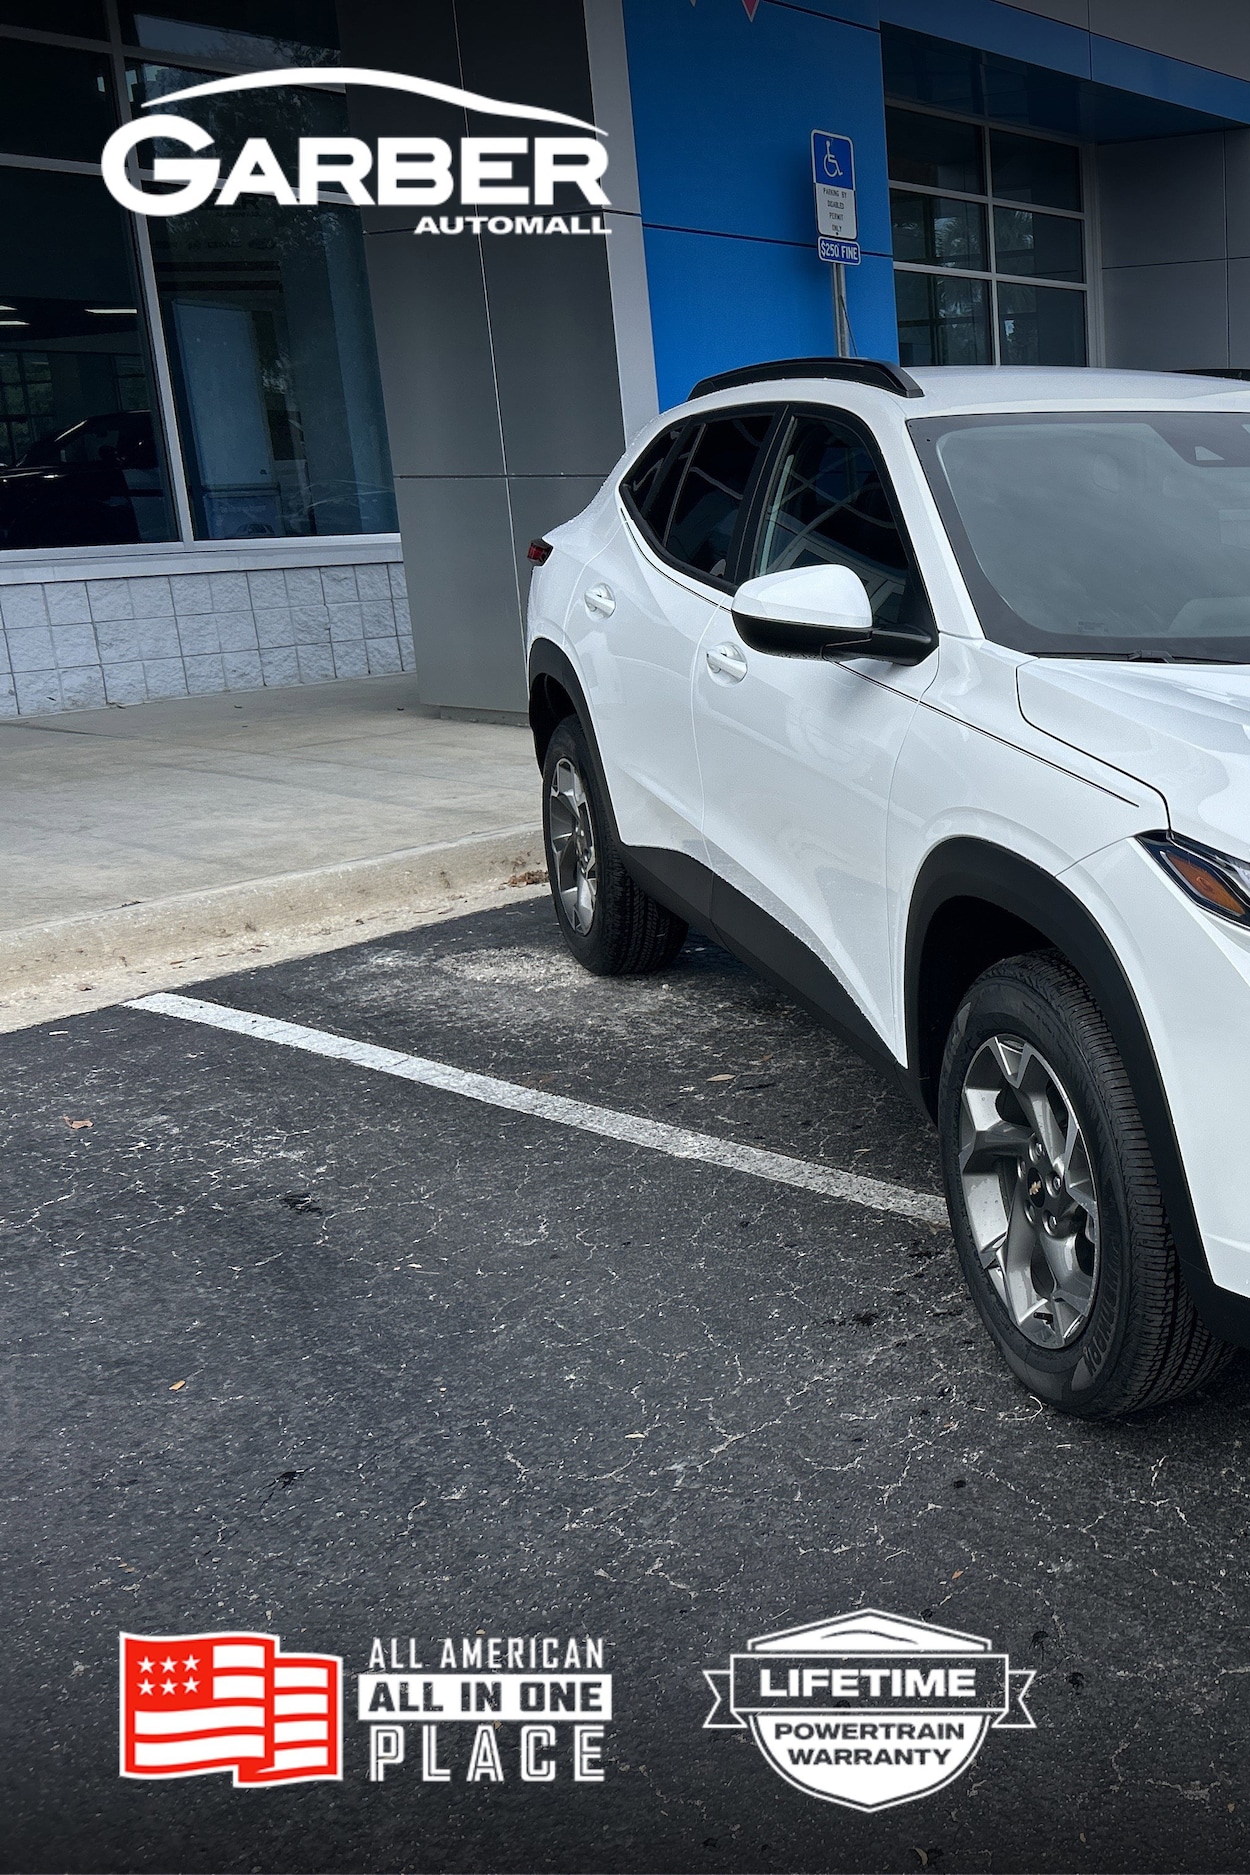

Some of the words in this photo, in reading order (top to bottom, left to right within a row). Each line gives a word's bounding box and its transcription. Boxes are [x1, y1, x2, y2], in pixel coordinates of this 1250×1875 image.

[841, 191, 847, 199] BY
[820, 240, 840, 258] $250
[841, 245, 859, 261] FINE
